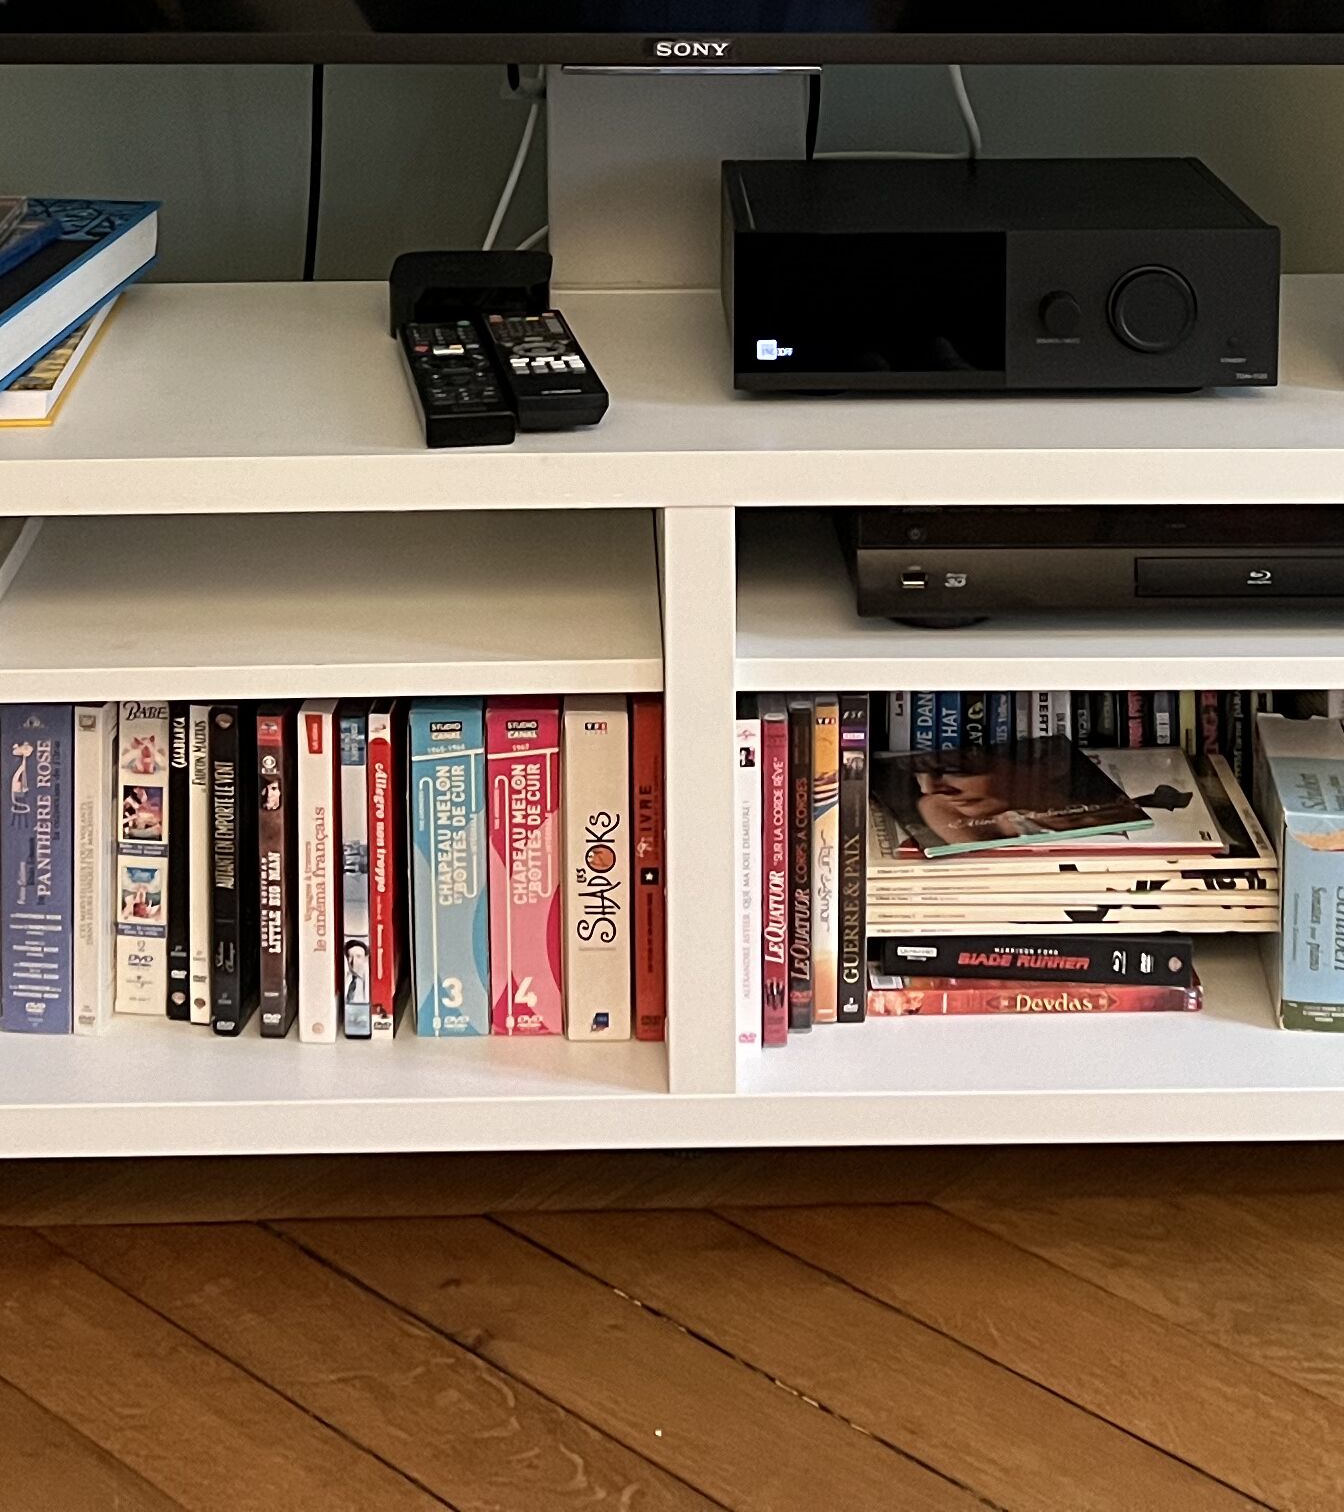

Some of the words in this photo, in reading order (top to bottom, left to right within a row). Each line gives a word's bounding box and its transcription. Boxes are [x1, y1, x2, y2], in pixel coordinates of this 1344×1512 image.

[656, 42, 729, 57] SONY
[123, 701, 168, 721] BABE
[917, 690, 933, 726] DAN
[172, 717, 187, 768] CASABLANCA
[37, 739, 51, 788] ROSE
[214, 761, 234, 784] VENT
[527, 763, 540, 799] CUIR
[214, 785, 235, 795] LE
[373, 763, 387, 818] Allegro
[436, 765, 452, 825] MELON
[451, 765, 465, 801] CUIR
[511, 764, 526, 824] MELON
[214, 798, 235, 839] EMPORTE
[452, 808, 465, 826] DE
[527, 807, 541, 826] DE
[772, 788, 784, 825] CORDE
[795, 778, 807, 829] CORDES
[34, 795, 51, 896] PANTHÈRE
[214, 840, 235, 853] EN
[311, 807, 327, 878] français
[376, 822, 386, 846] non
[772, 828, 784, 840] LA
[214, 855, 235, 889] AUTANT
[268, 852, 281, 881] MAN
[374, 848, 386, 892] troppo
[439, 828, 453, 905] CHAPEAU
[453, 829, 467, 890] BOTTES
[512, 827, 527, 905] CHAPEAU
[527, 829, 541, 890] BOTTES
[796, 842, 808, 883] CORPS
[842, 833, 860, 878] PAIX
[576, 867, 587, 883] LES
[577, 811, 621, 943] SHADOKS
[843, 881, 858, 896] &
[268, 886, 282, 906] BIG
[312, 879, 326, 937] cinéma
[268, 910, 282, 953] LITTLE
[313, 940, 326, 952] le
[843, 898, 860, 983] GUERRE
[128, 954, 154, 966] DVD
[958, 952, 1011, 967] BLADE
[1017, 955, 1090, 970] RUNNER
[442, 977, 463, 1007] 3
[514, 976, 537, 1007] 4
[1016, 992, 1093, 1013] Devdas
